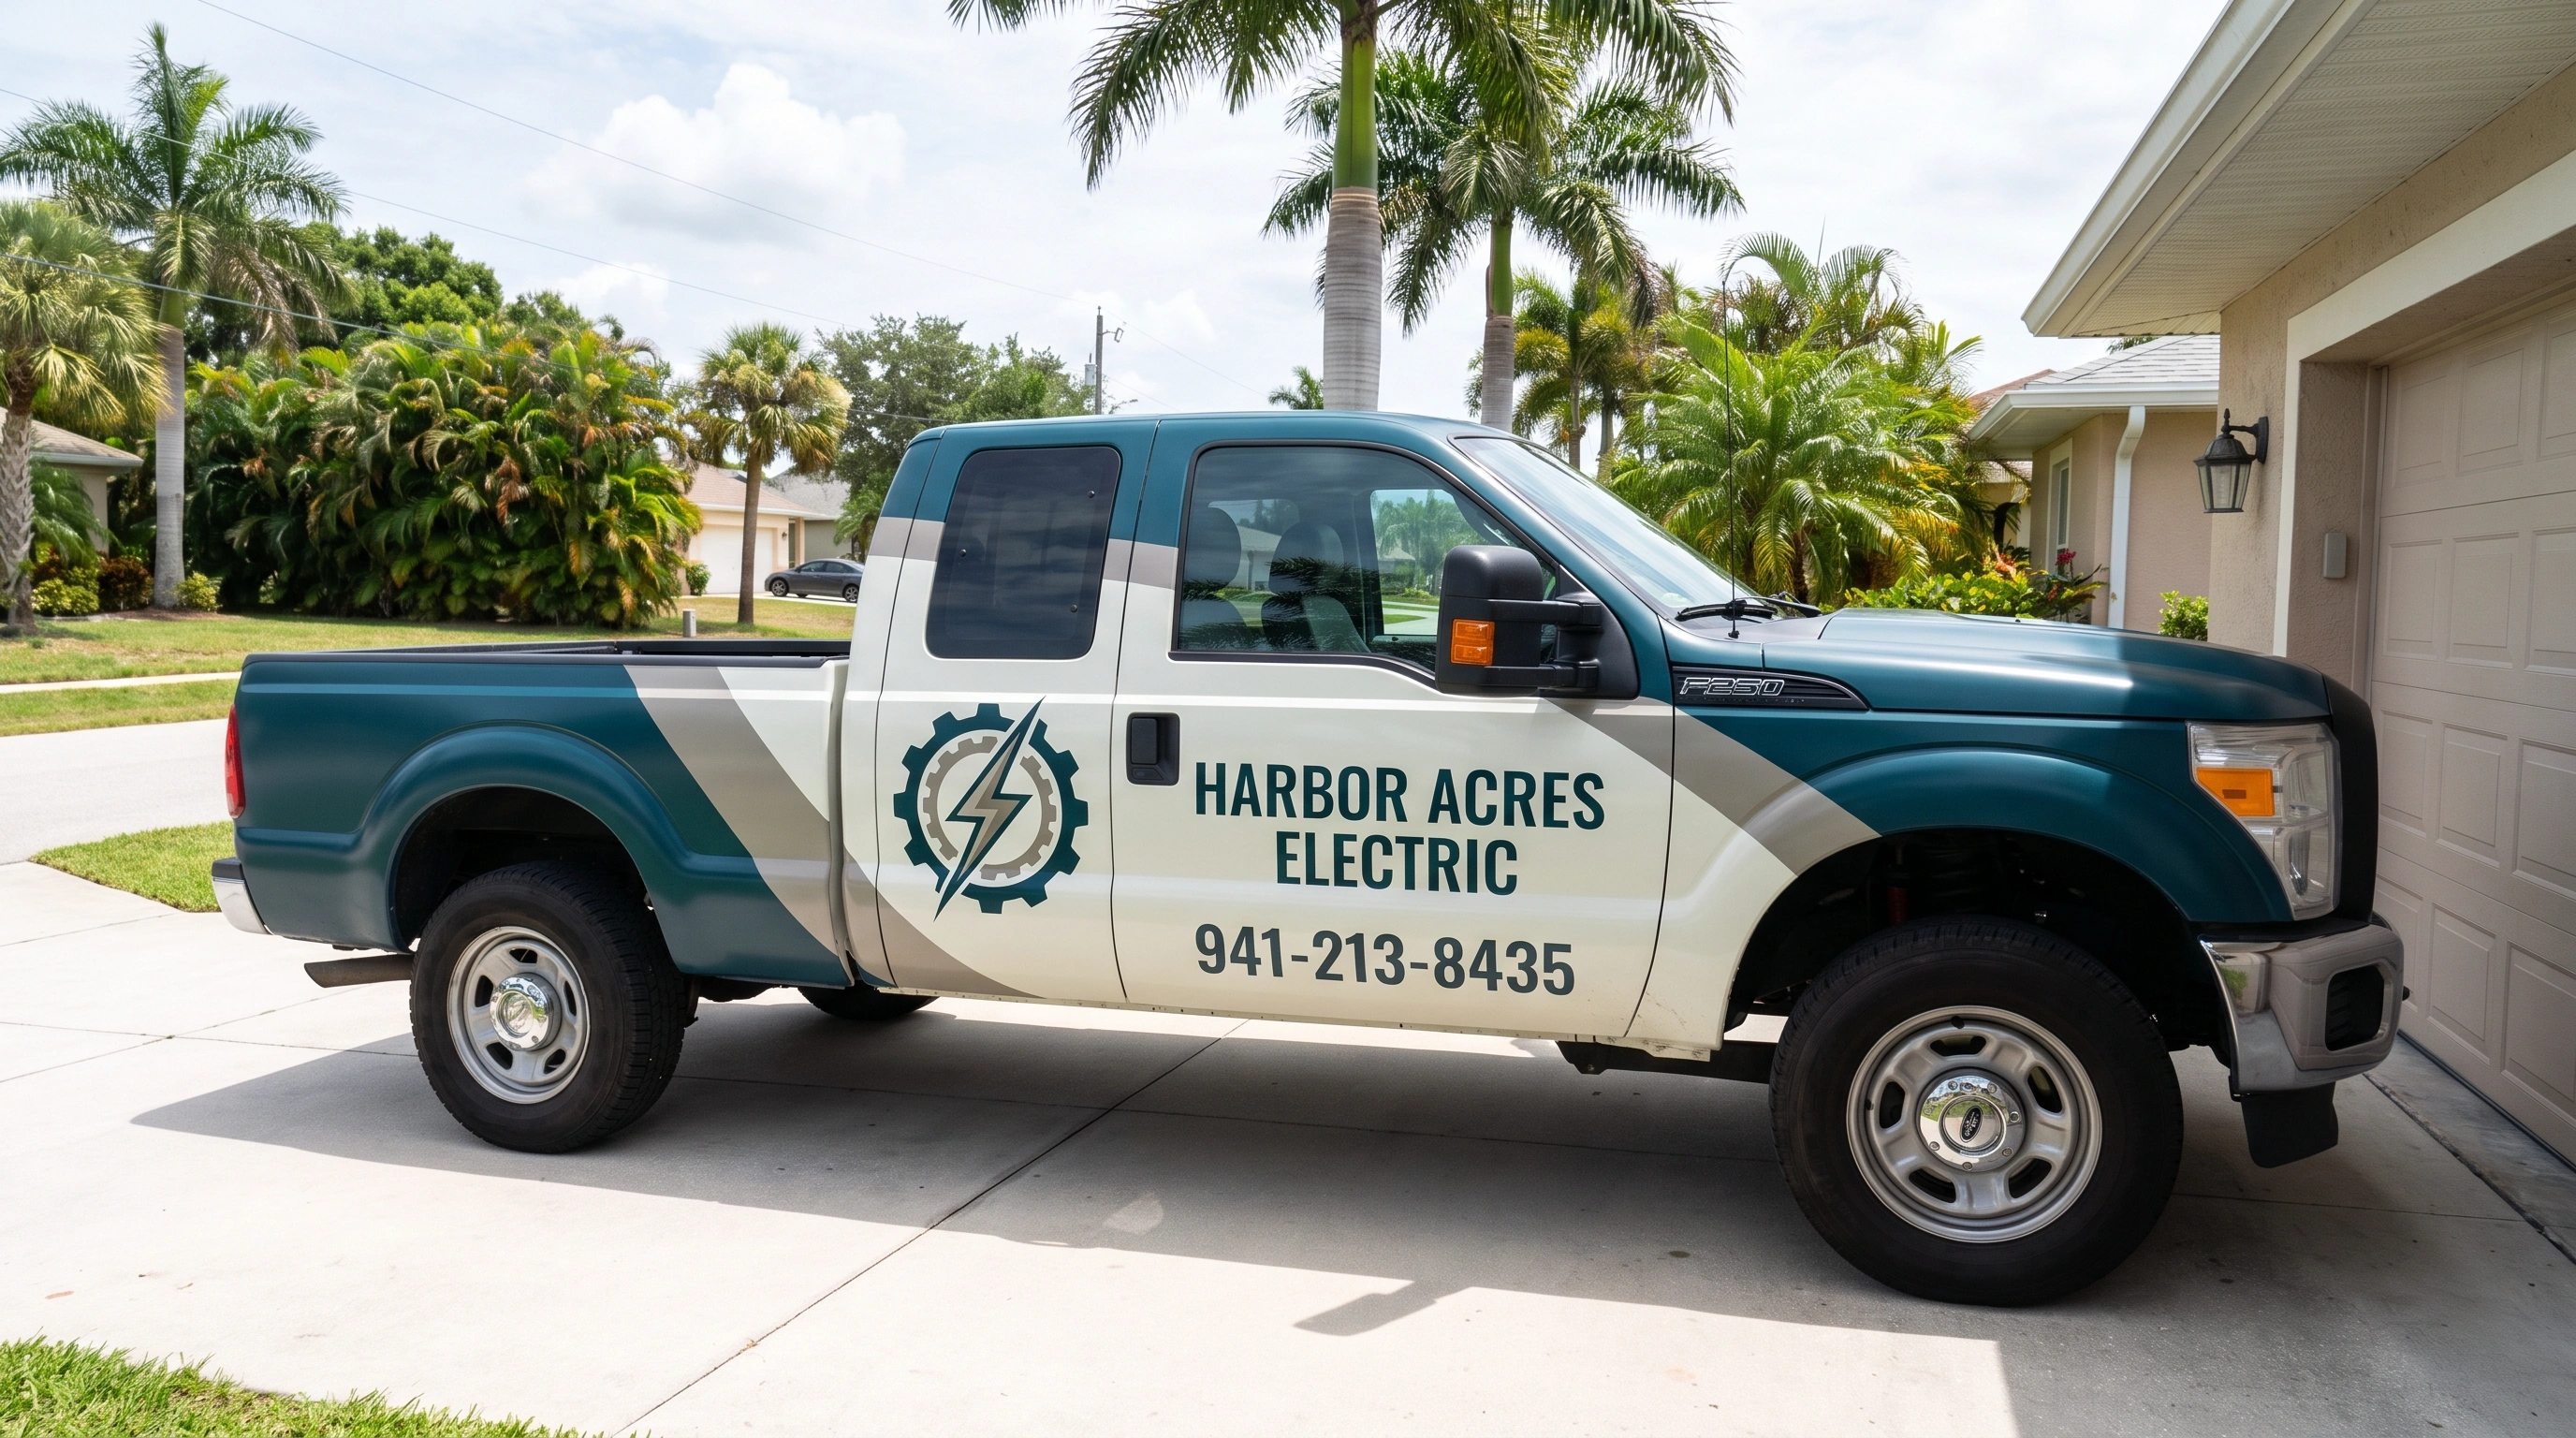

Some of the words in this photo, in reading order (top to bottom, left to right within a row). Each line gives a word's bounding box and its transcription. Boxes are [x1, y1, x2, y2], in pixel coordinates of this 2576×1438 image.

[1679, 677, 1785, 697] F250
[1195, 761, 1409, 823] HARBOR
[1427, 768, 1605, 830] ACRES
[1276, 830, 1518, 896] ELECTRIC
[1195, 923, 1575, 996] 941-213-8435
